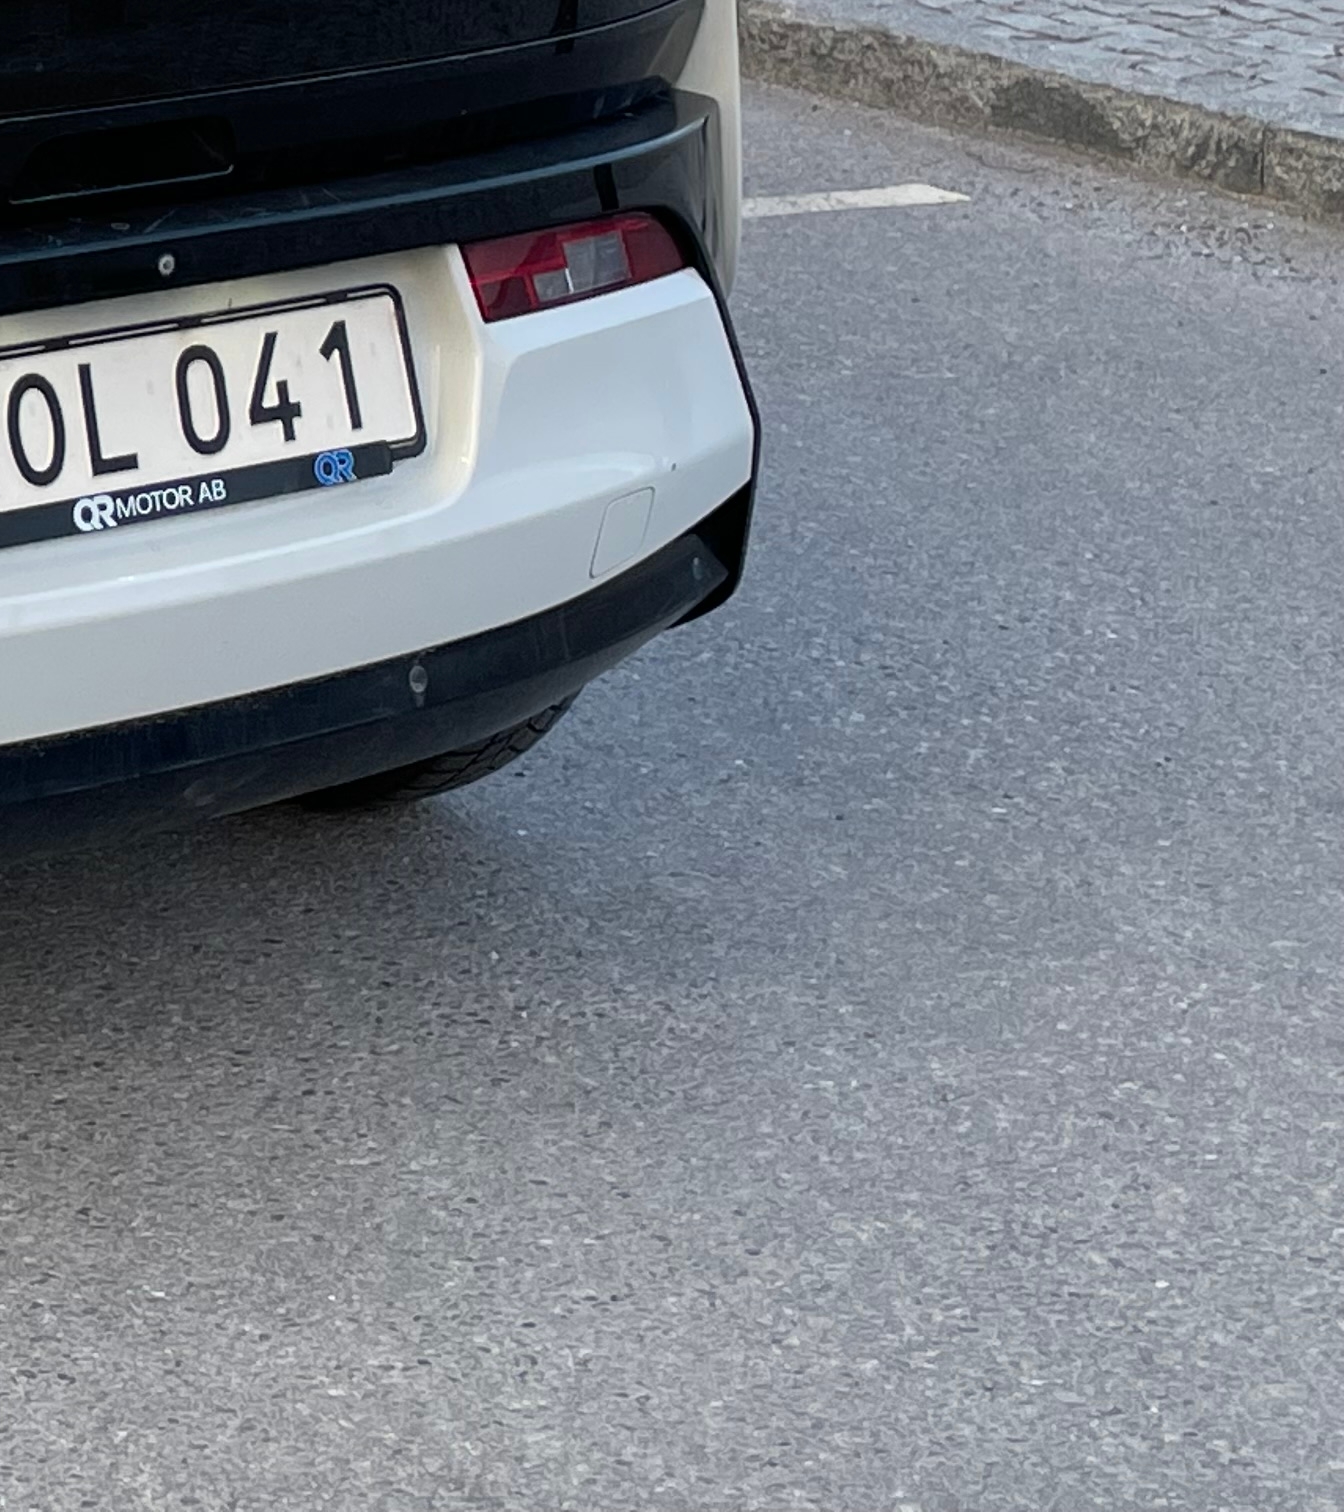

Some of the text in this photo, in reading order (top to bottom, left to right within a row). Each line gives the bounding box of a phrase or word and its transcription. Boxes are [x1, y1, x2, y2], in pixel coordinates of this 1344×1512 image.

[175, 319, 364, 456] 041
[115, 485, 194, 519] MOTOR
[197, 478, 227, 504] AB
